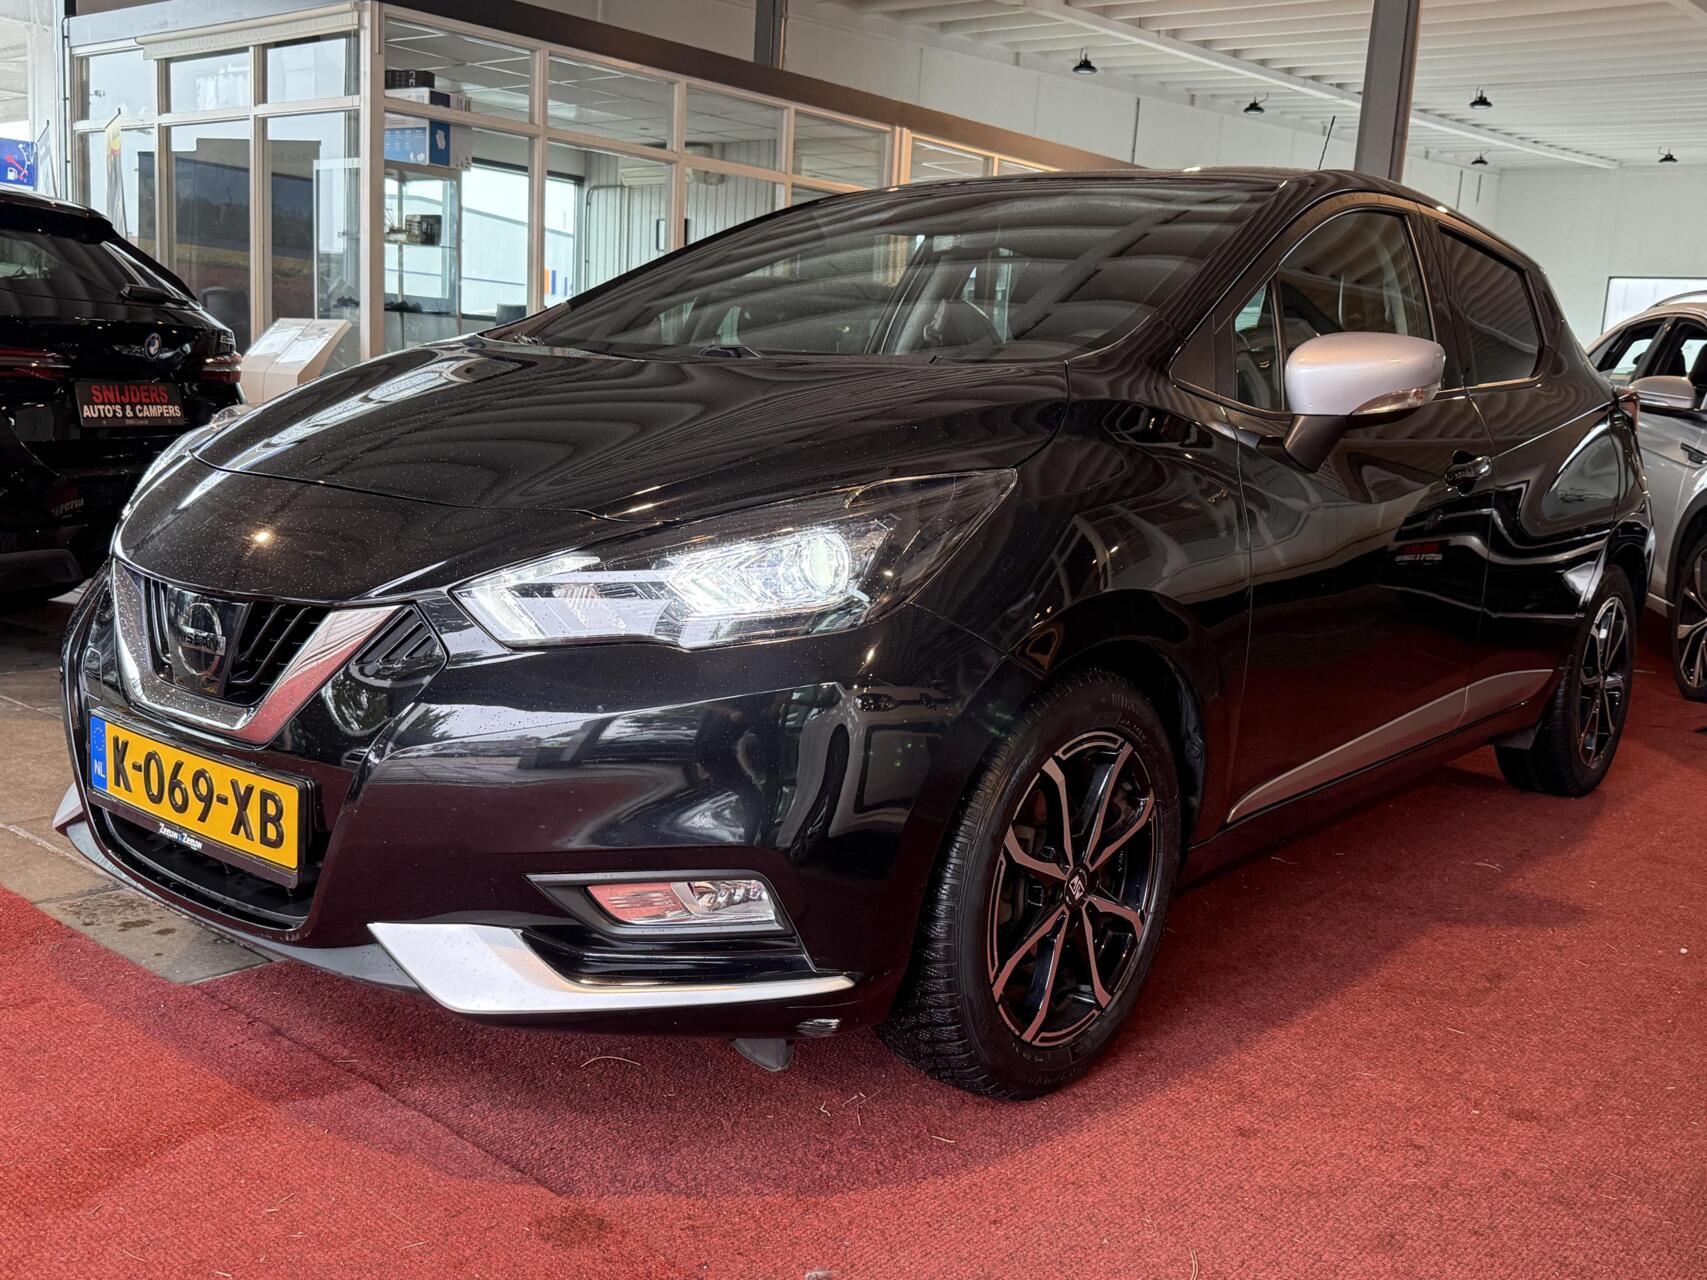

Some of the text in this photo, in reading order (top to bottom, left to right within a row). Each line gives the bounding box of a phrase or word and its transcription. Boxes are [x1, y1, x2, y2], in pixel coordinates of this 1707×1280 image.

[91, 385, 168, 403] SNIJDERS
[83, 405, 181, 418] AUTO'S & CAMPERS
[94, 759, 106, 778] NL
[112, 735, 285, 849] K-069-XB
